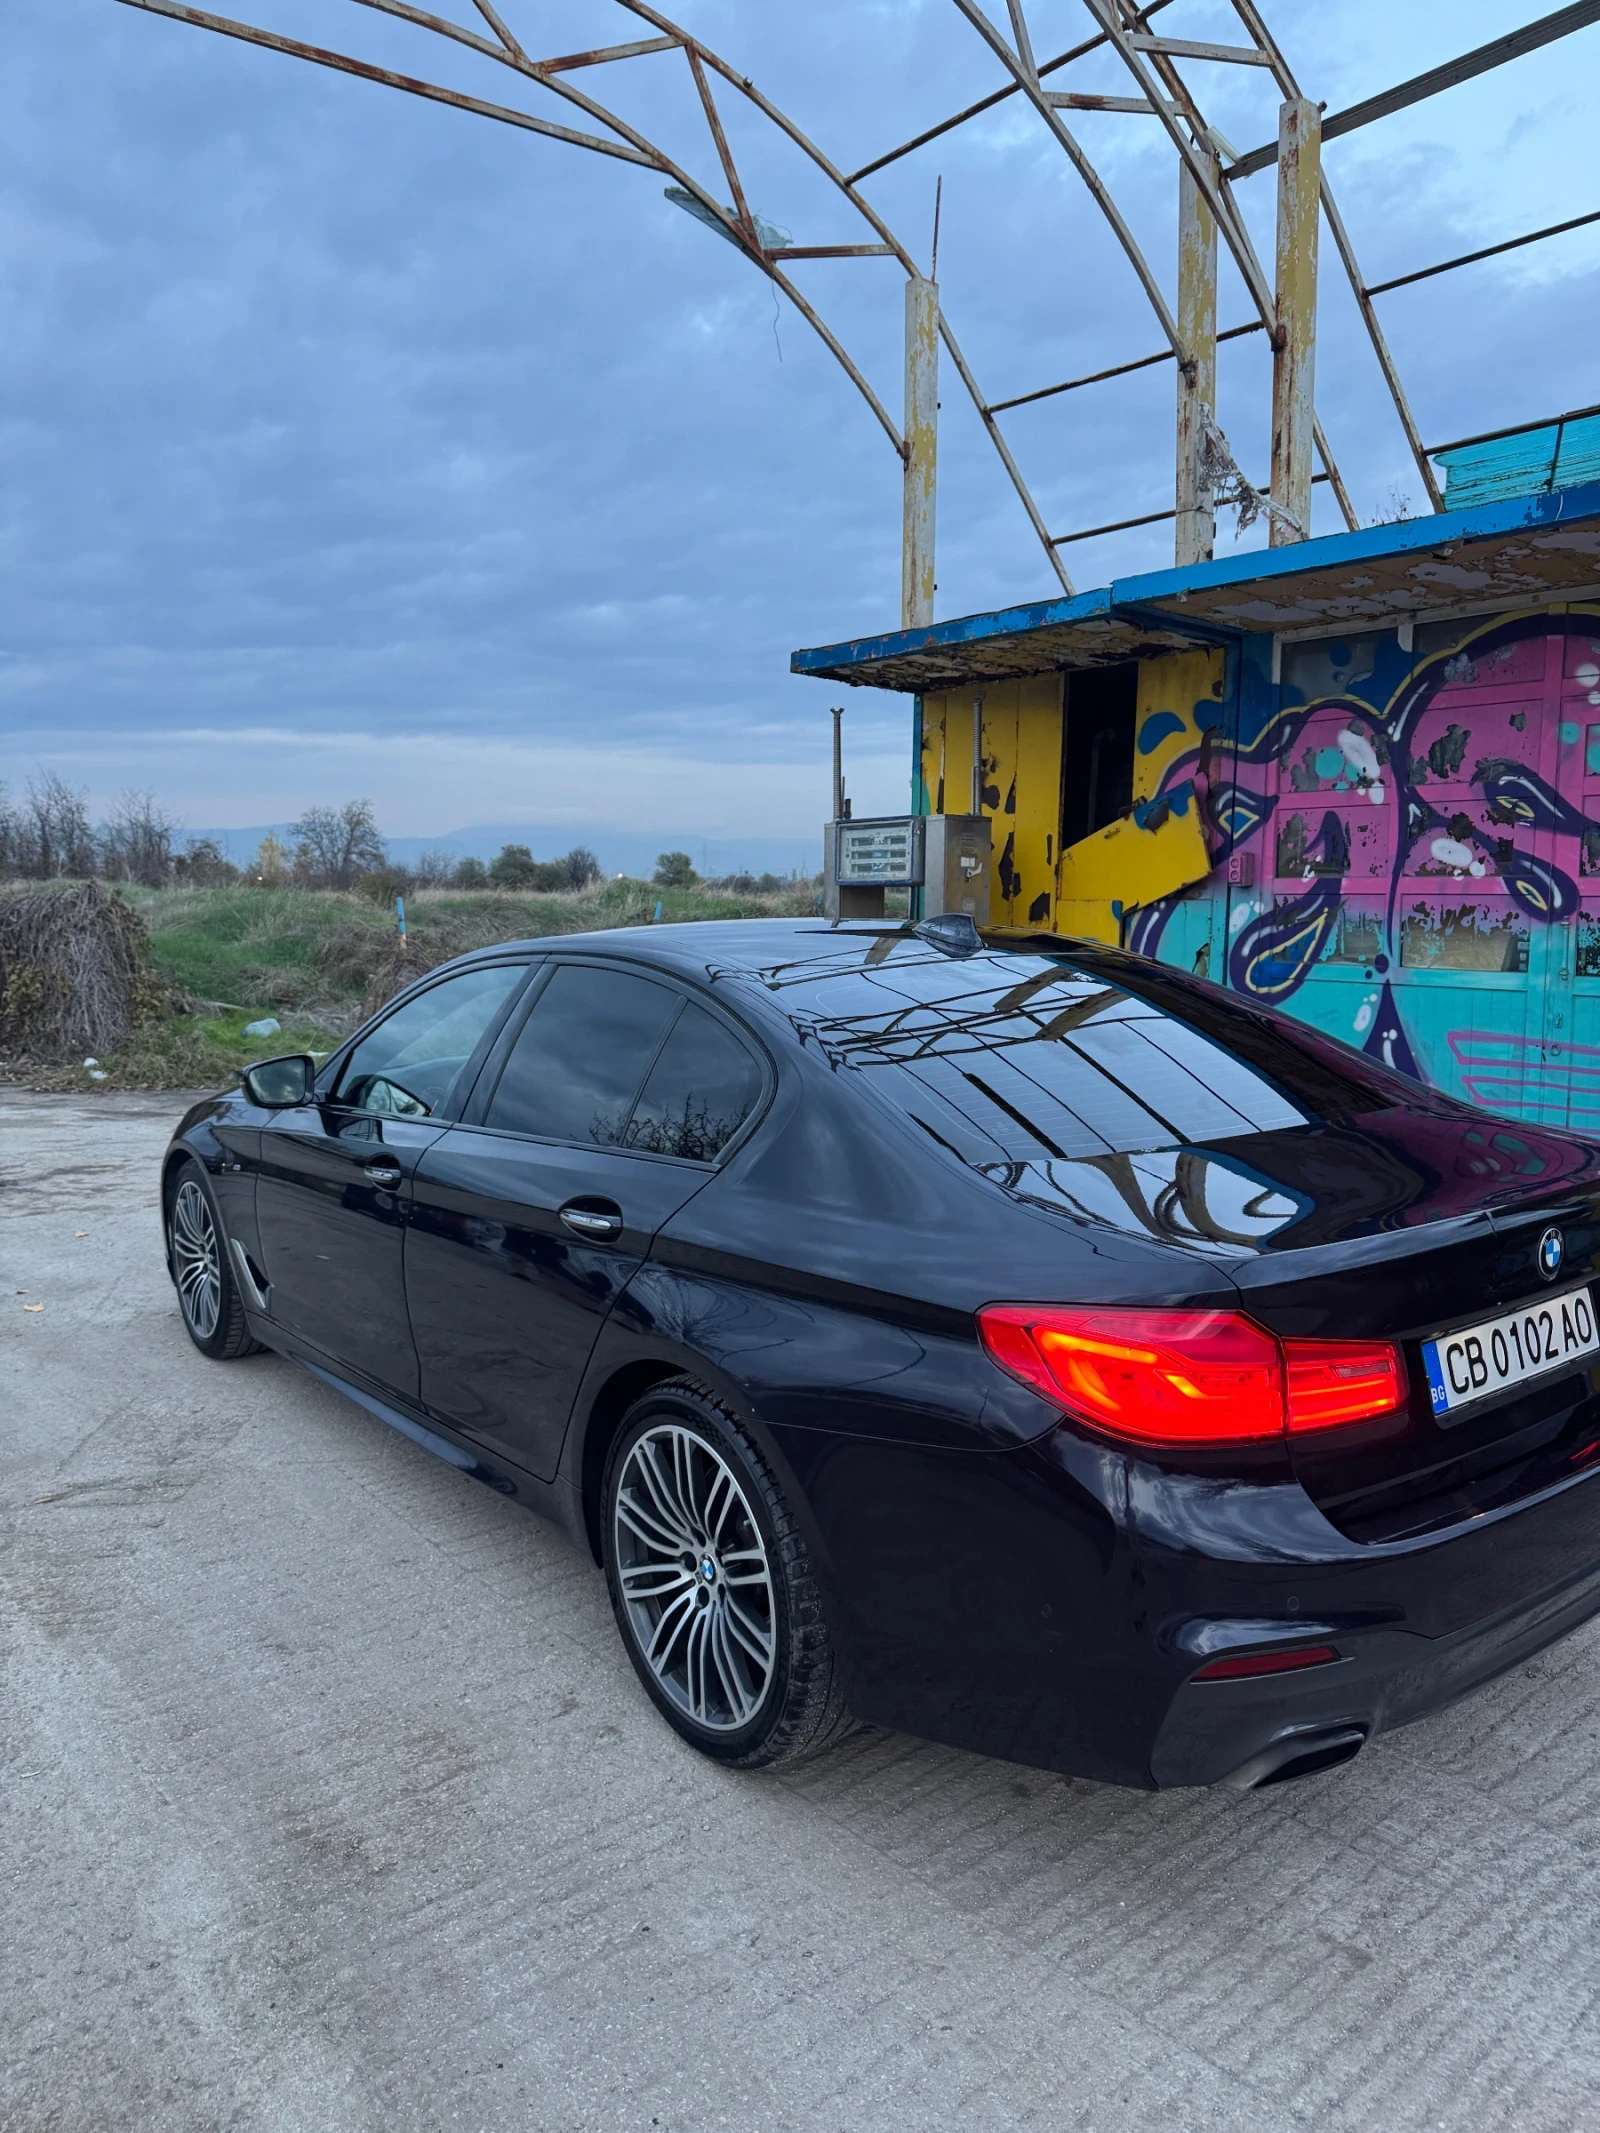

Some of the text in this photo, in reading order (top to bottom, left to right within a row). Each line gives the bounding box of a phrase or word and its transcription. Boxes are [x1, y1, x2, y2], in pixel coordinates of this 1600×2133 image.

[1446, 1336, 1488, 1394] CB
[1491, 1310, 1559, 1377] 0102
[1430, 1385, 1445, 1403] BG
